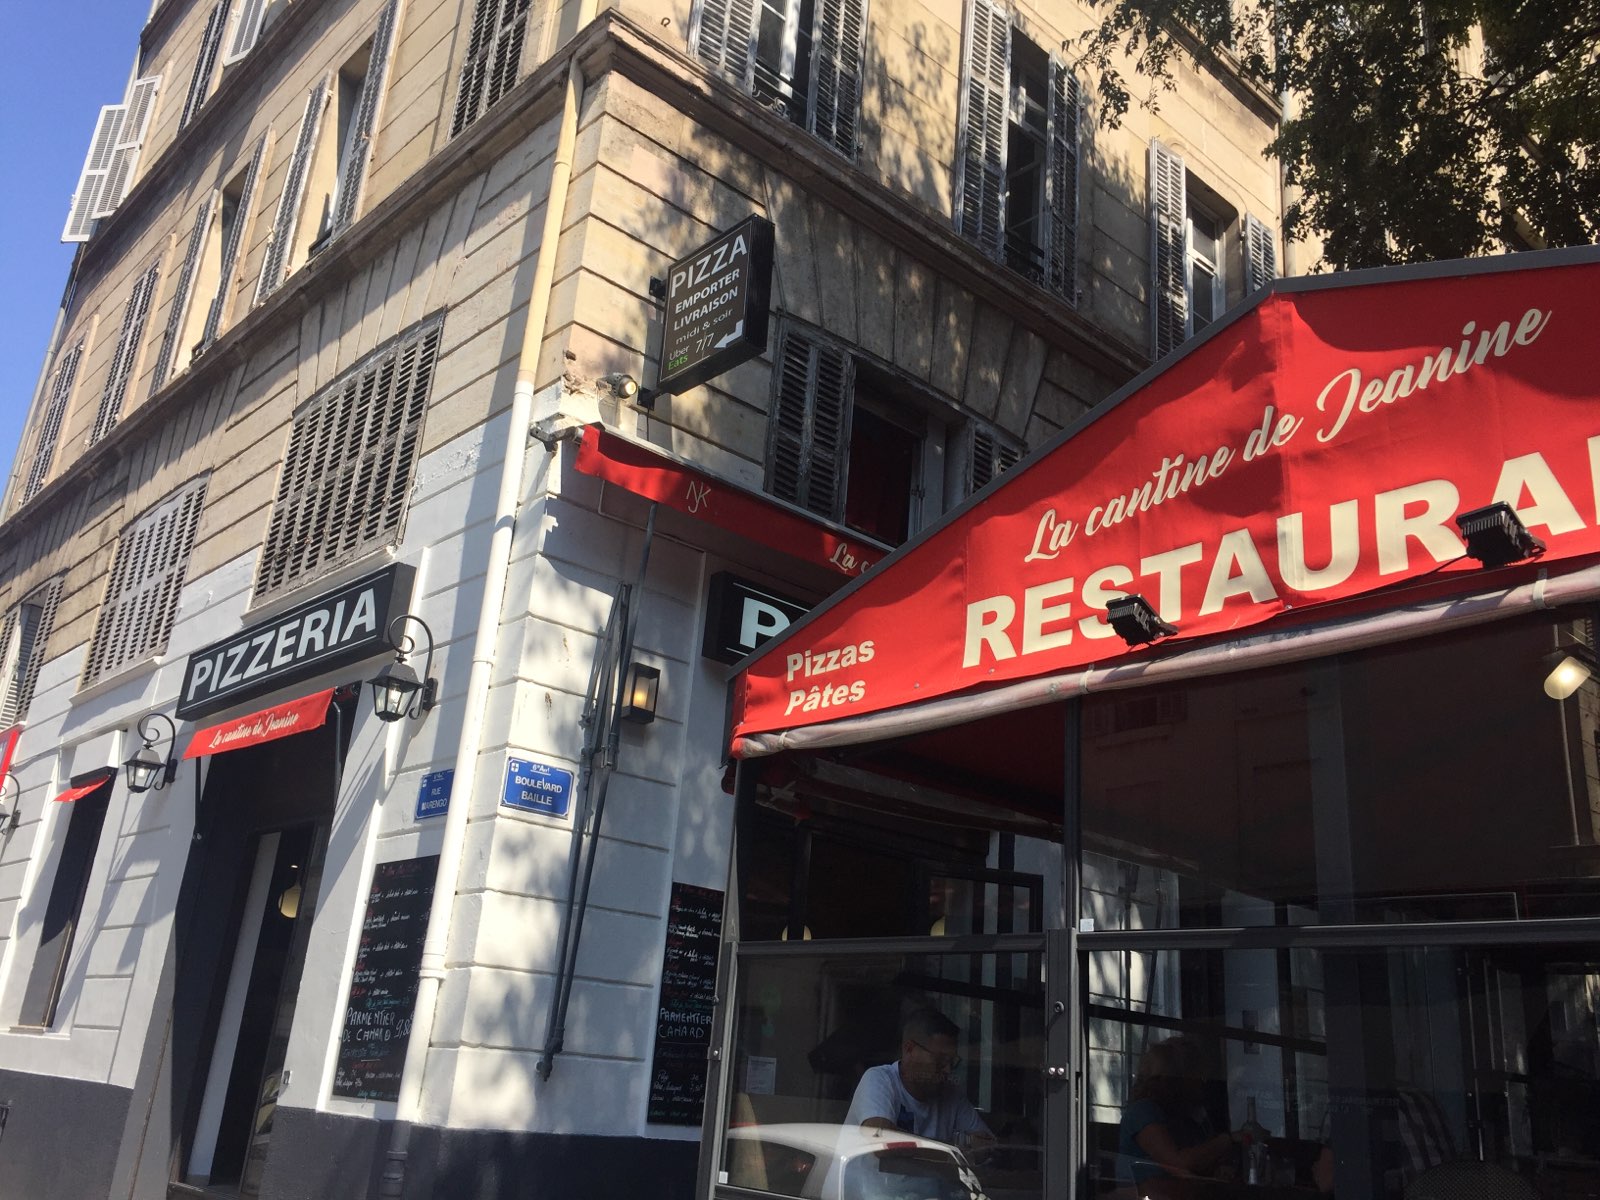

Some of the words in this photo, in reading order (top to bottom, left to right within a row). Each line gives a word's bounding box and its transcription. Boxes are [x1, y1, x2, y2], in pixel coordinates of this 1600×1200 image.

[671, 234, 748, 298] PIZZA
[673, 286, 739, 331] LIVRAISON
[675, 268, 740, 315] EMPORTER
[676, 325, 700, 345] midi
[702, 321, 711, 330] &
[712, 308, 733, 326] soir
[695, 332, 715, 354] 7/7
[668, 354, 689, 370] Eats
[669, 345, 690, 360] Uber
[1024, 509, 1078, 563] La
[1084, 446, 1236, 536] cantine
[1243, 405, 1304, 461] de
[1316, 308, 1552, 442] Jeanine
[829, 543, 859, 574] La
[962, 434, 1600, 669] RESTAURA
[186, 587, 377, 702] PIZZERIA
[786, 640, 875, 682] Pizzas
[784, 680, 866, 716] Pâtes
[208, 729, 222, 748] La
[221, 723, 252, 743] cantine
[252, 718, 264, 736] de
[515, 775, 563, 793] BOULEVARD
[521, 790, 553, 806] BAILLE
